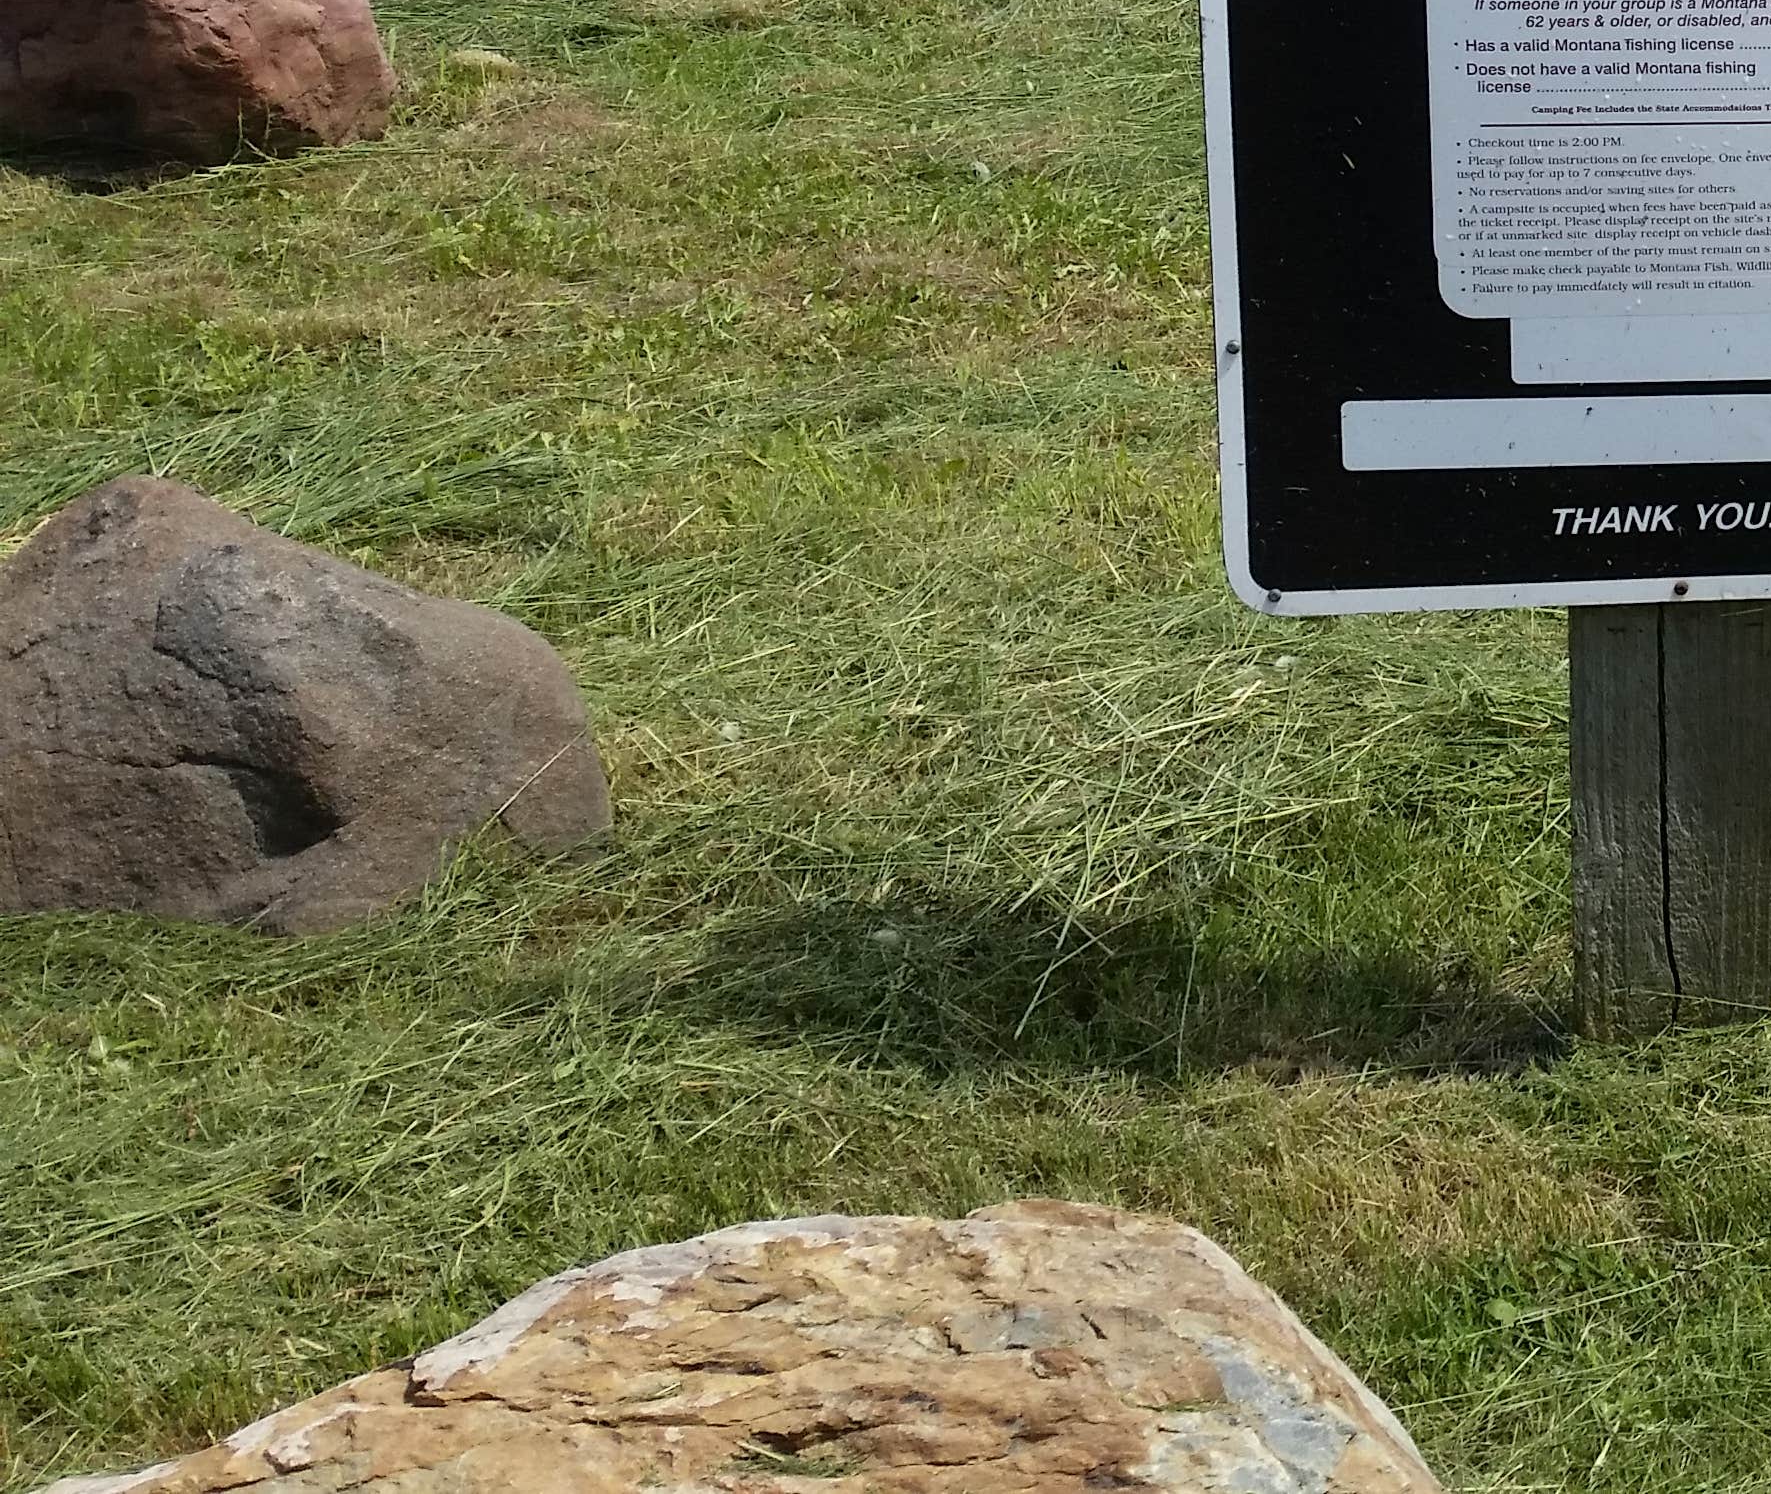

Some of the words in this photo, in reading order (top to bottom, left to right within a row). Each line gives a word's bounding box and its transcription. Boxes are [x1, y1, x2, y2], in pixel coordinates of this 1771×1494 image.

[1488, 0, 1560, 11] someone
[1582, 0, 1618, 16] your
[1620, 0, 1666, 16] group
[1686, 0, 1697, 10] a
[1525, 14, 1545, 28] 62
[1547, 17, 1590, 31] years
[1593, 14, 1606, 28] &
[1609, 14, 1652, 30] older,
[1656, 16, 1674, 27] or
[1676, 13, 1748, 29] disabled,
[1465, 38, 1496, 53] Has
[1499, 41, 1510, 52] a
[1512, 38, 1550, 52] valid
[1555, 38, 1622, 52] Montana
[1623, 37, 1677, 54] fishing
[1681, 37, 1735, 51] license
[1466, 62, 1507, 76] Does
[1510, 62, 1536, 76] not
[1540, 62, 1577, 76] have
[1580, 64, 1591, 75] a
[1594, 61, 1630, 75] valid
[1635, 61, 1702, 75] Montana
[1704, 60, 1756, 77] fishing
[1477, 78, 1532, 94] license
[1531, 105, 1574, 116] Camping
[1576, 105, 1592, 114] Fee
[1594, 105, 1635, 113] Includes
[1636, 104, 1654, 113] the
[1655, 104, 1680, 113] State
[1468, 137, 1525, 148] Checkout
[1558, 138, 1569, 147] is
[1571, 137, 1600, 147] 2:00
[1468, 155, 1506, 166] Please
[1509, 155, 1545, 166] follow
[1548, 155, 1620, 165] instructions
[1622, 155, 1638, 165] on
[1640, 153, 1658, 164] fee
[1718, 152, 1743, 163] One
[1456, 168, 1485, 180] used
[1488, 167, 1501, 179] to
[1503, 170, 1525, 182] pay
[1527, 168, 1545, 179] for
[1546, 170, 1565, 182] up
[1568, 169, 1580, 178] to
[1583, 167, 1591, 178] 7
[1593, 168, 1662, 179] consecutive
[1665, 166, 1696, 179] days.
[1468, 186, 1486, 197] No
[1489, 187, 1562, 197] reservations
[1565, 185, 1603, 196] and/or
[1606, 185, 1646, 197] saving
[1647, 185, 1675, 195] sites
[1677, 184, 1695, 194] for
[1697, 183, 1736, 194] others
[1472, 265, 1510, 276] Please
[1512, 264, 1546, 276] make
[1548, 264, 1583, 275] check
[1586, 263, 1631, 277] payable
[1634, 263, 1647, 274] to
[1649, 263, 1701, 273] Montana
[1472, 282, 1514, 294] Failure
[1517, 283, 1529, 293] to
[1532, 284, 1553, 295] pay
[1556, 280, 1629, 294] immediately
[1631, 279, 1653, 291] will
[1655, 279, 1690, 291] result
[1692, 280, 1705, 290] in
[1551, 504, 1675, 535] THANK
